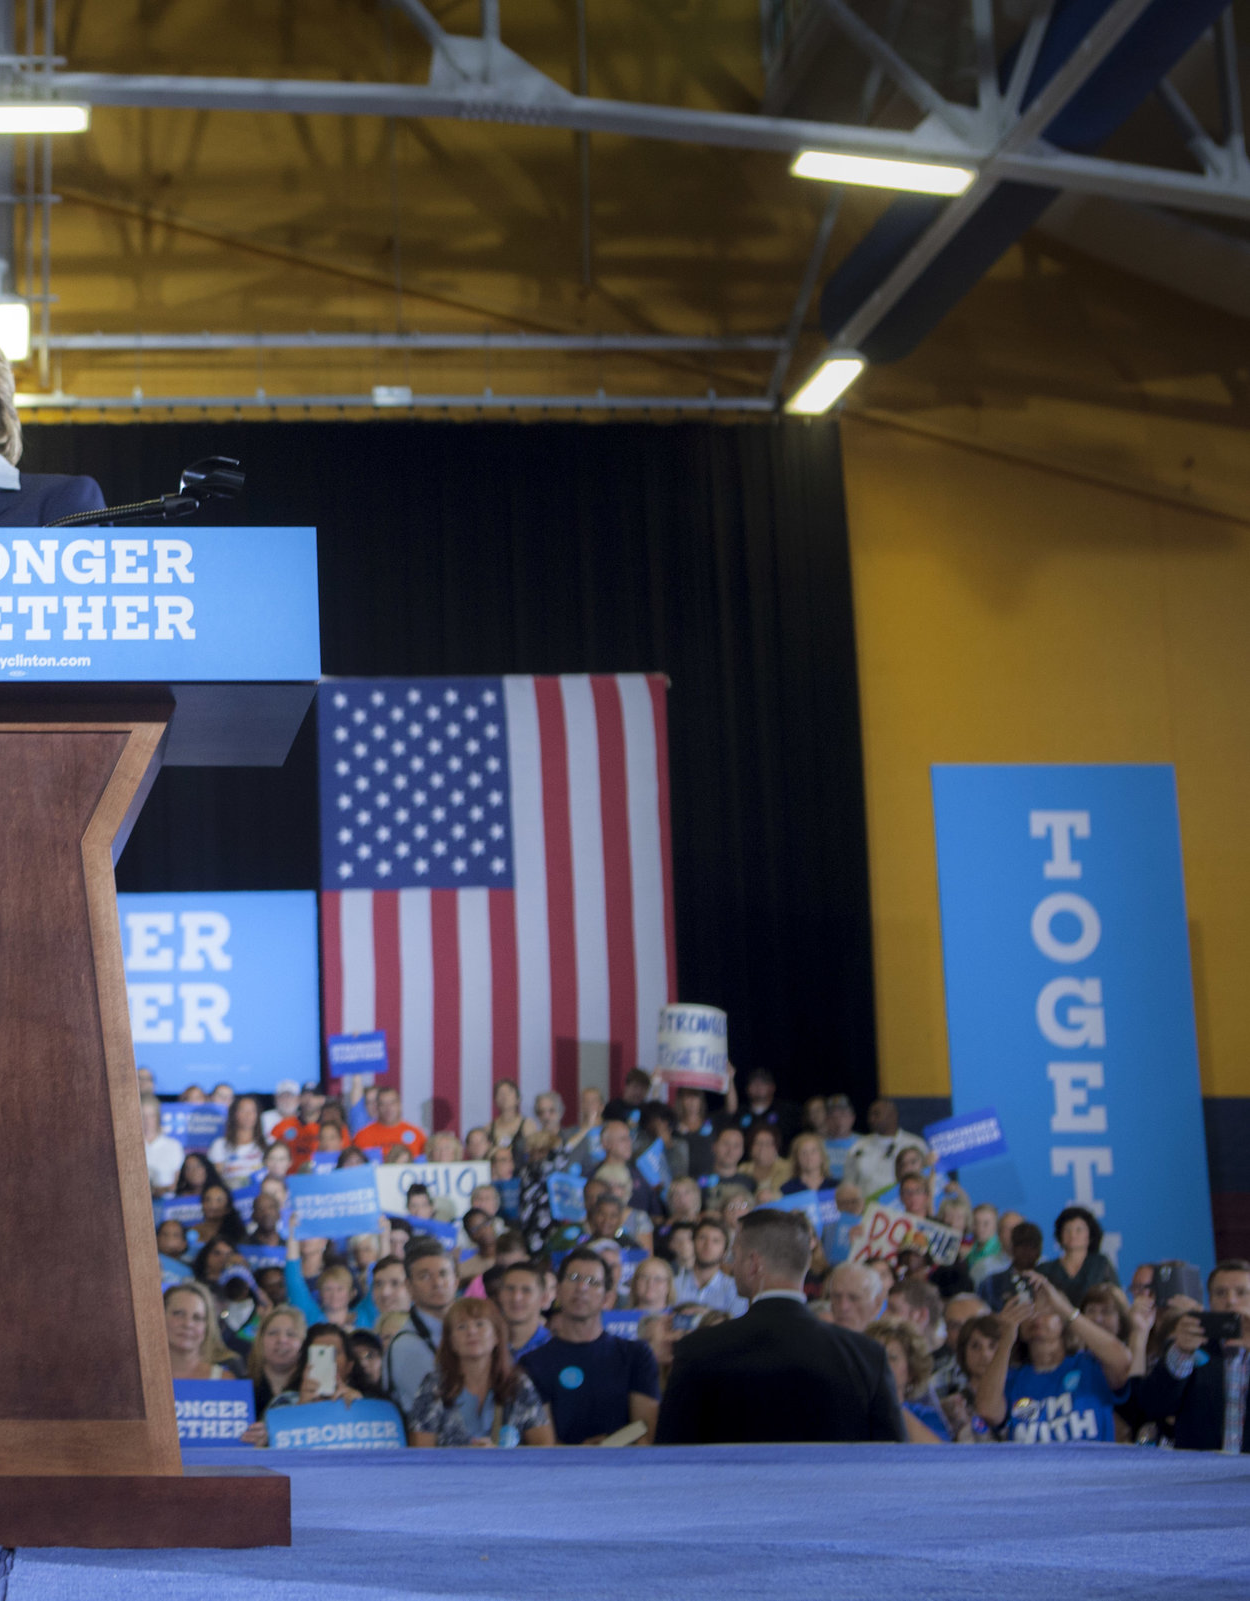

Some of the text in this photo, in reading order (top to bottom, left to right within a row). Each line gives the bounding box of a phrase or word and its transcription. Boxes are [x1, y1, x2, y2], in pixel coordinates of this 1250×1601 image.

[1029, 810, 1122, 1272] TOGET
[397, 1167, 478, 1198] OHIO
[295, 1188, 375, 1207] STRONGER
[296, 1202, 377, 1219] TOGETHER
[175, 1400, 248, 1419] ONGER
[177, 1419, 249, 1439] ETHER
[275, 1421, 399, 1448] STRONGER
[1013, 1408, 1098, 1444] WITH
